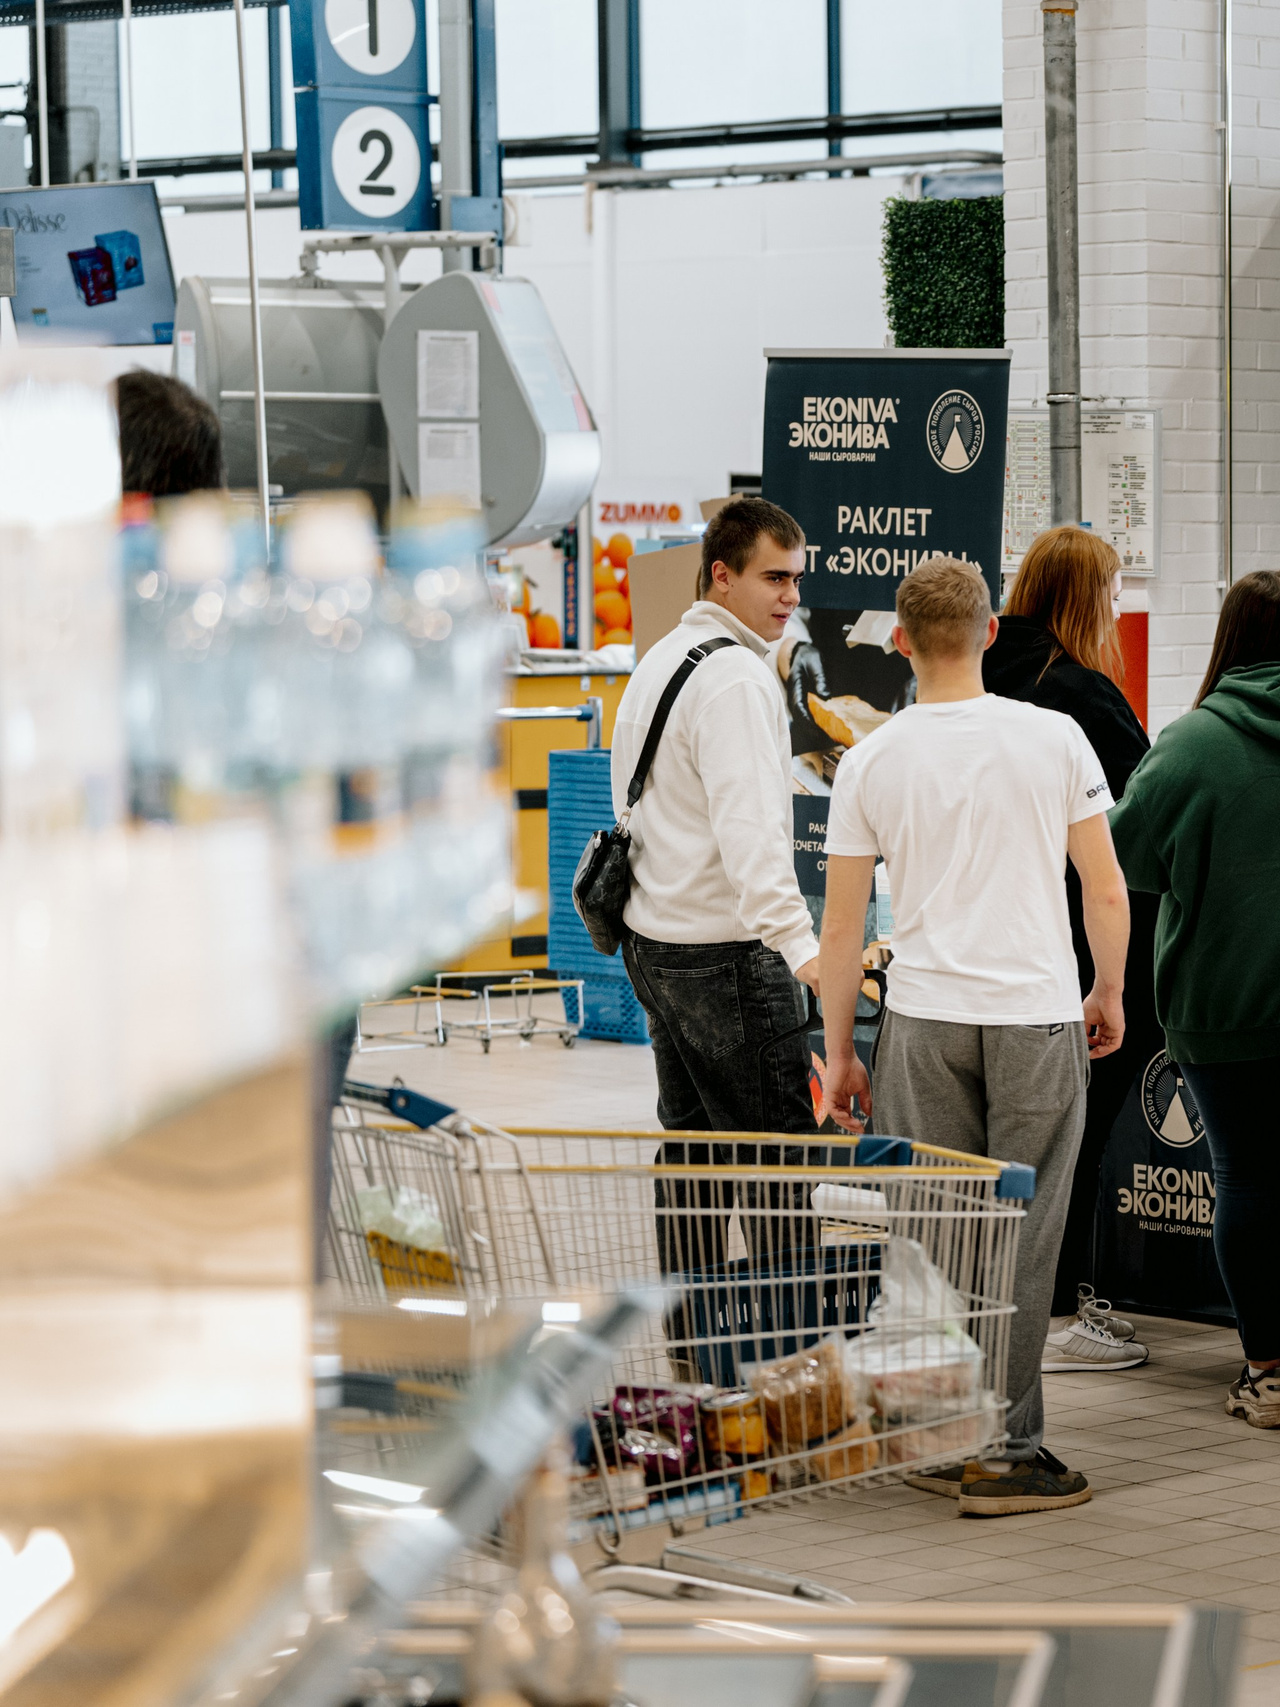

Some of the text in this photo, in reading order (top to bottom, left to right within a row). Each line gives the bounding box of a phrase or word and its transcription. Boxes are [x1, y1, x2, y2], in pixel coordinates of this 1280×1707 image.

[359, 129, 395, 195] 2
[803, 397, 898, 423] EKONIVA
[788, 422, 890, 449] ЭКОНИВА
[930, 395, 981, 458] НОВОЕ ПОКОЛЕНИЕ СЫРОВ РОССИИ
[808, 451, 876, 463] НАШИ СЫРОВАРНИ
[837, 505, 932, 537] РАКЛЕТ
[804, 545, 983, 577] Т «ЭКОНИ»
[808, 822, 828, 835] РАК
[1146, 1092, 1161, 1126] НОВОЕ
[1117, 1187, 1216, 1225] ЭКОНИВ
[1139, 1220, 1213, 1239] НАШИ СЫРОВАРНИ
